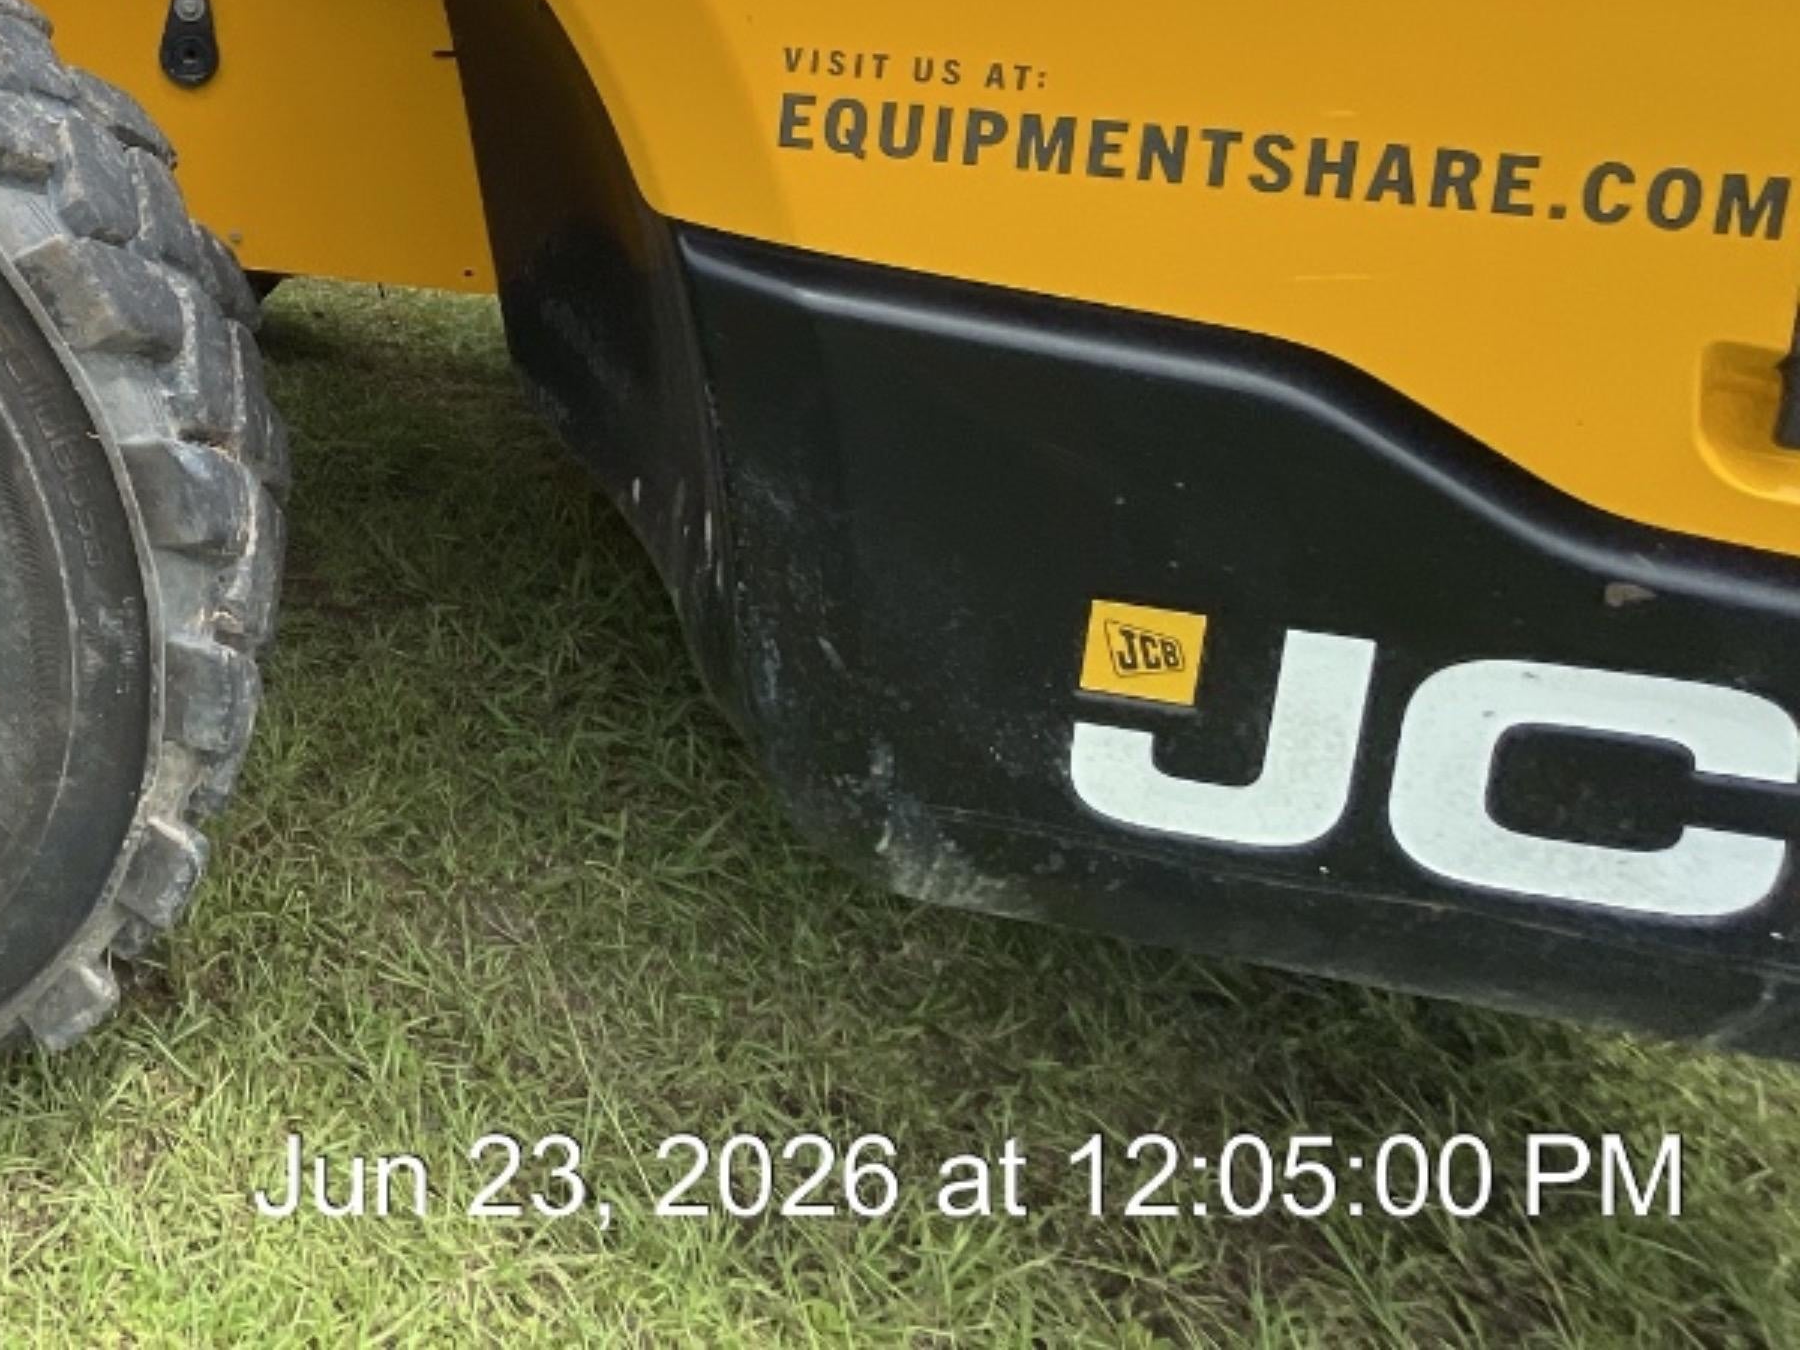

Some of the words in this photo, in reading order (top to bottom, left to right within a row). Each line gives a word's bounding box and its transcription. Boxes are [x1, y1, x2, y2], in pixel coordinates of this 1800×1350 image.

[783, 46, 890, 80] VISIT
[912, 56, 962, 86] US
[983, 61, 1049, 91] AT:
[777, 92, 1792, 241] EQUIPMENTSHARE.COM
[1116, 626, 1181, 671] JCB
